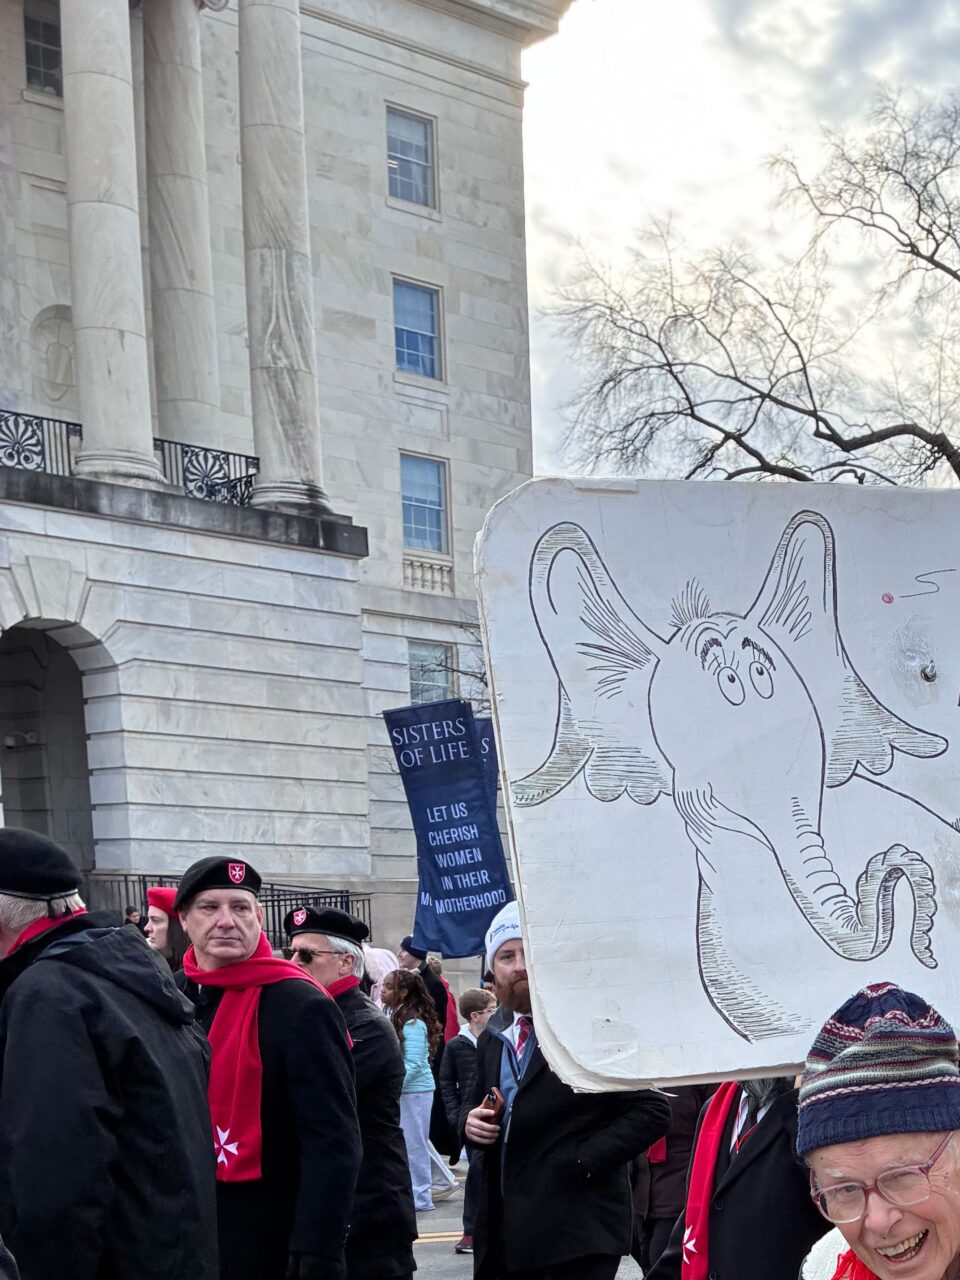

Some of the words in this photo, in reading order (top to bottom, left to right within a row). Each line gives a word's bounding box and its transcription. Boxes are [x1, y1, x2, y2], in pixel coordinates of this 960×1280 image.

[392, 717, 466, 746] SISTERS
[400, 747, 424, 768] OF
[429, 740, 469, 764] LIFE
[426, 805, 448, 823] LET
[450, 802, 468, 819] US
[428, 824, 479, 846] CHERISH
[435, 847, 483, 868] WOMEN
[441, 876, 453, 890] IN
[453, 869, 492, 889] THEIR
[435, 889, 506, 914] MOTHERHOOD
